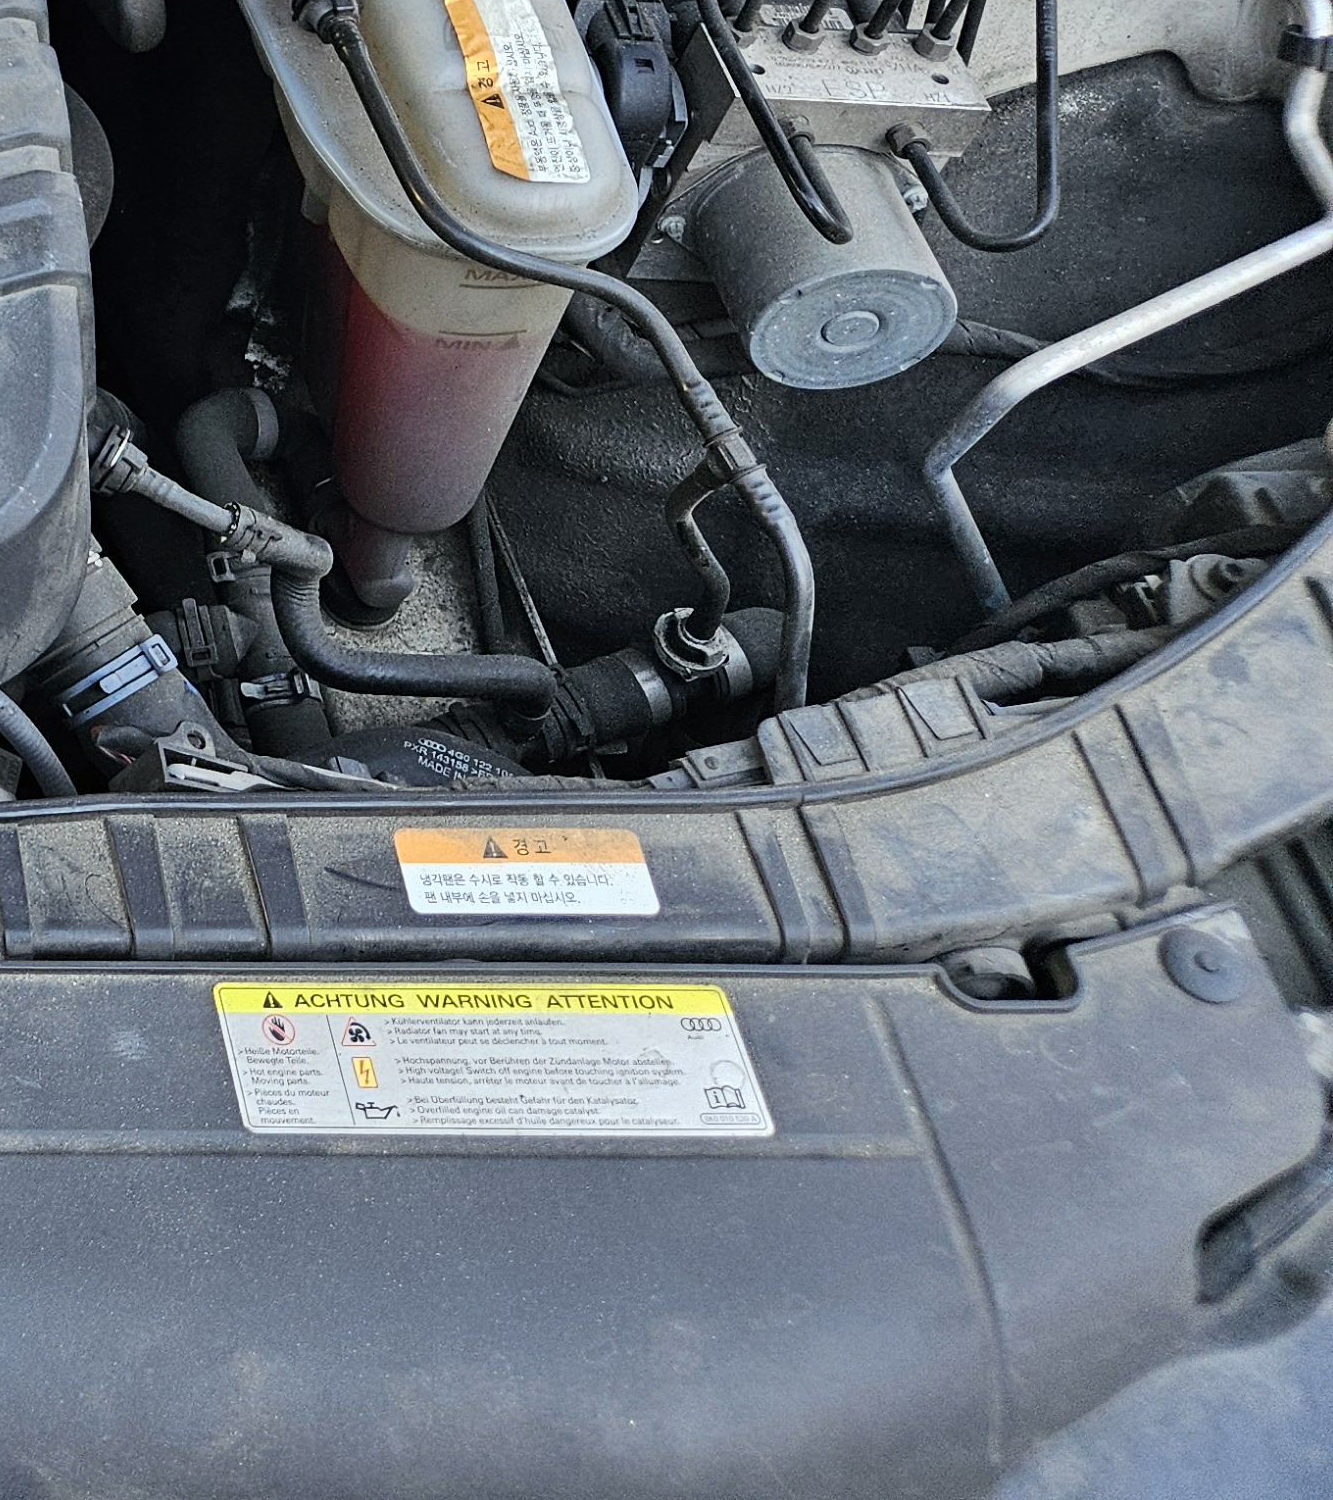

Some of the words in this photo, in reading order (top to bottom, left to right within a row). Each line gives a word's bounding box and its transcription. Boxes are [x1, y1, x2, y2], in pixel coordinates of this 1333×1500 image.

[435, 338, 491, 350] MIN
[404, 741, 428, 755] PXR
[418, 756, 451, 778] MADE
[473, 759, 492, 772] 122
[420, 873, 466, 887] 냉각팬은
[469, 874, 504, 887] 수시로
[506, 874, 530, 887] 작동
[533, 873, 545, 887] 할
[548, 873, 560, 887] 수
[563, 873, 614, 887] 있습니다.
[424, 891, 438, 904] 팬
[439, 891, 476, 904] 내부에
[478, 891, 502, 905] 손을
[504, 891, 529, 904] 넣지
[530, 891, 581, 905] 마십시오.
[294, 994, 405, 1009] ACHTUNG
[416, 994, 533, 1009] WARNING
[547, 994, 674, 1010] ATTENTION
[391, 1017, 461, 1027] Kühlerventilator
[462, 1018, 485, 1026] kann
[486, 1018, 524, 1027] jederzeit
[525, 1018, 565, 1026] anlaufen.
[432, 1028, 448, 1036] fan
[449, 1029, 469, 1037] may
[470, 1028, 491, 1036] start
[492, 1028, 501, 1036] at
[503, 1029, 519, 1037] any
[520, 1028, 542, 1036] time.
[246, 1056, 285, 1067] Bewegte
[285, 1057, 309, 1067] Teile.
[249, 1068, 266, 1078] Hot
[267, 1069, 298, 1078] engine
[299, 1069, 324, 1077] parts.
[406, 1067, 427, 1076] High
[465, 1067, 497, 1075] Switch
[498, 1067, 511, 1075] off
[512, 1068, 543, 1077] engine
[543, 1067, 573, 1076] before
[574, 1067, 615, 1077] touching
[616, 1068, 651, 1077] ignition
[651, 1068, 686, 1078] system.
[251, 1077, 285, 1087] Moving
[286, 1078, 309, 1087] parts.
